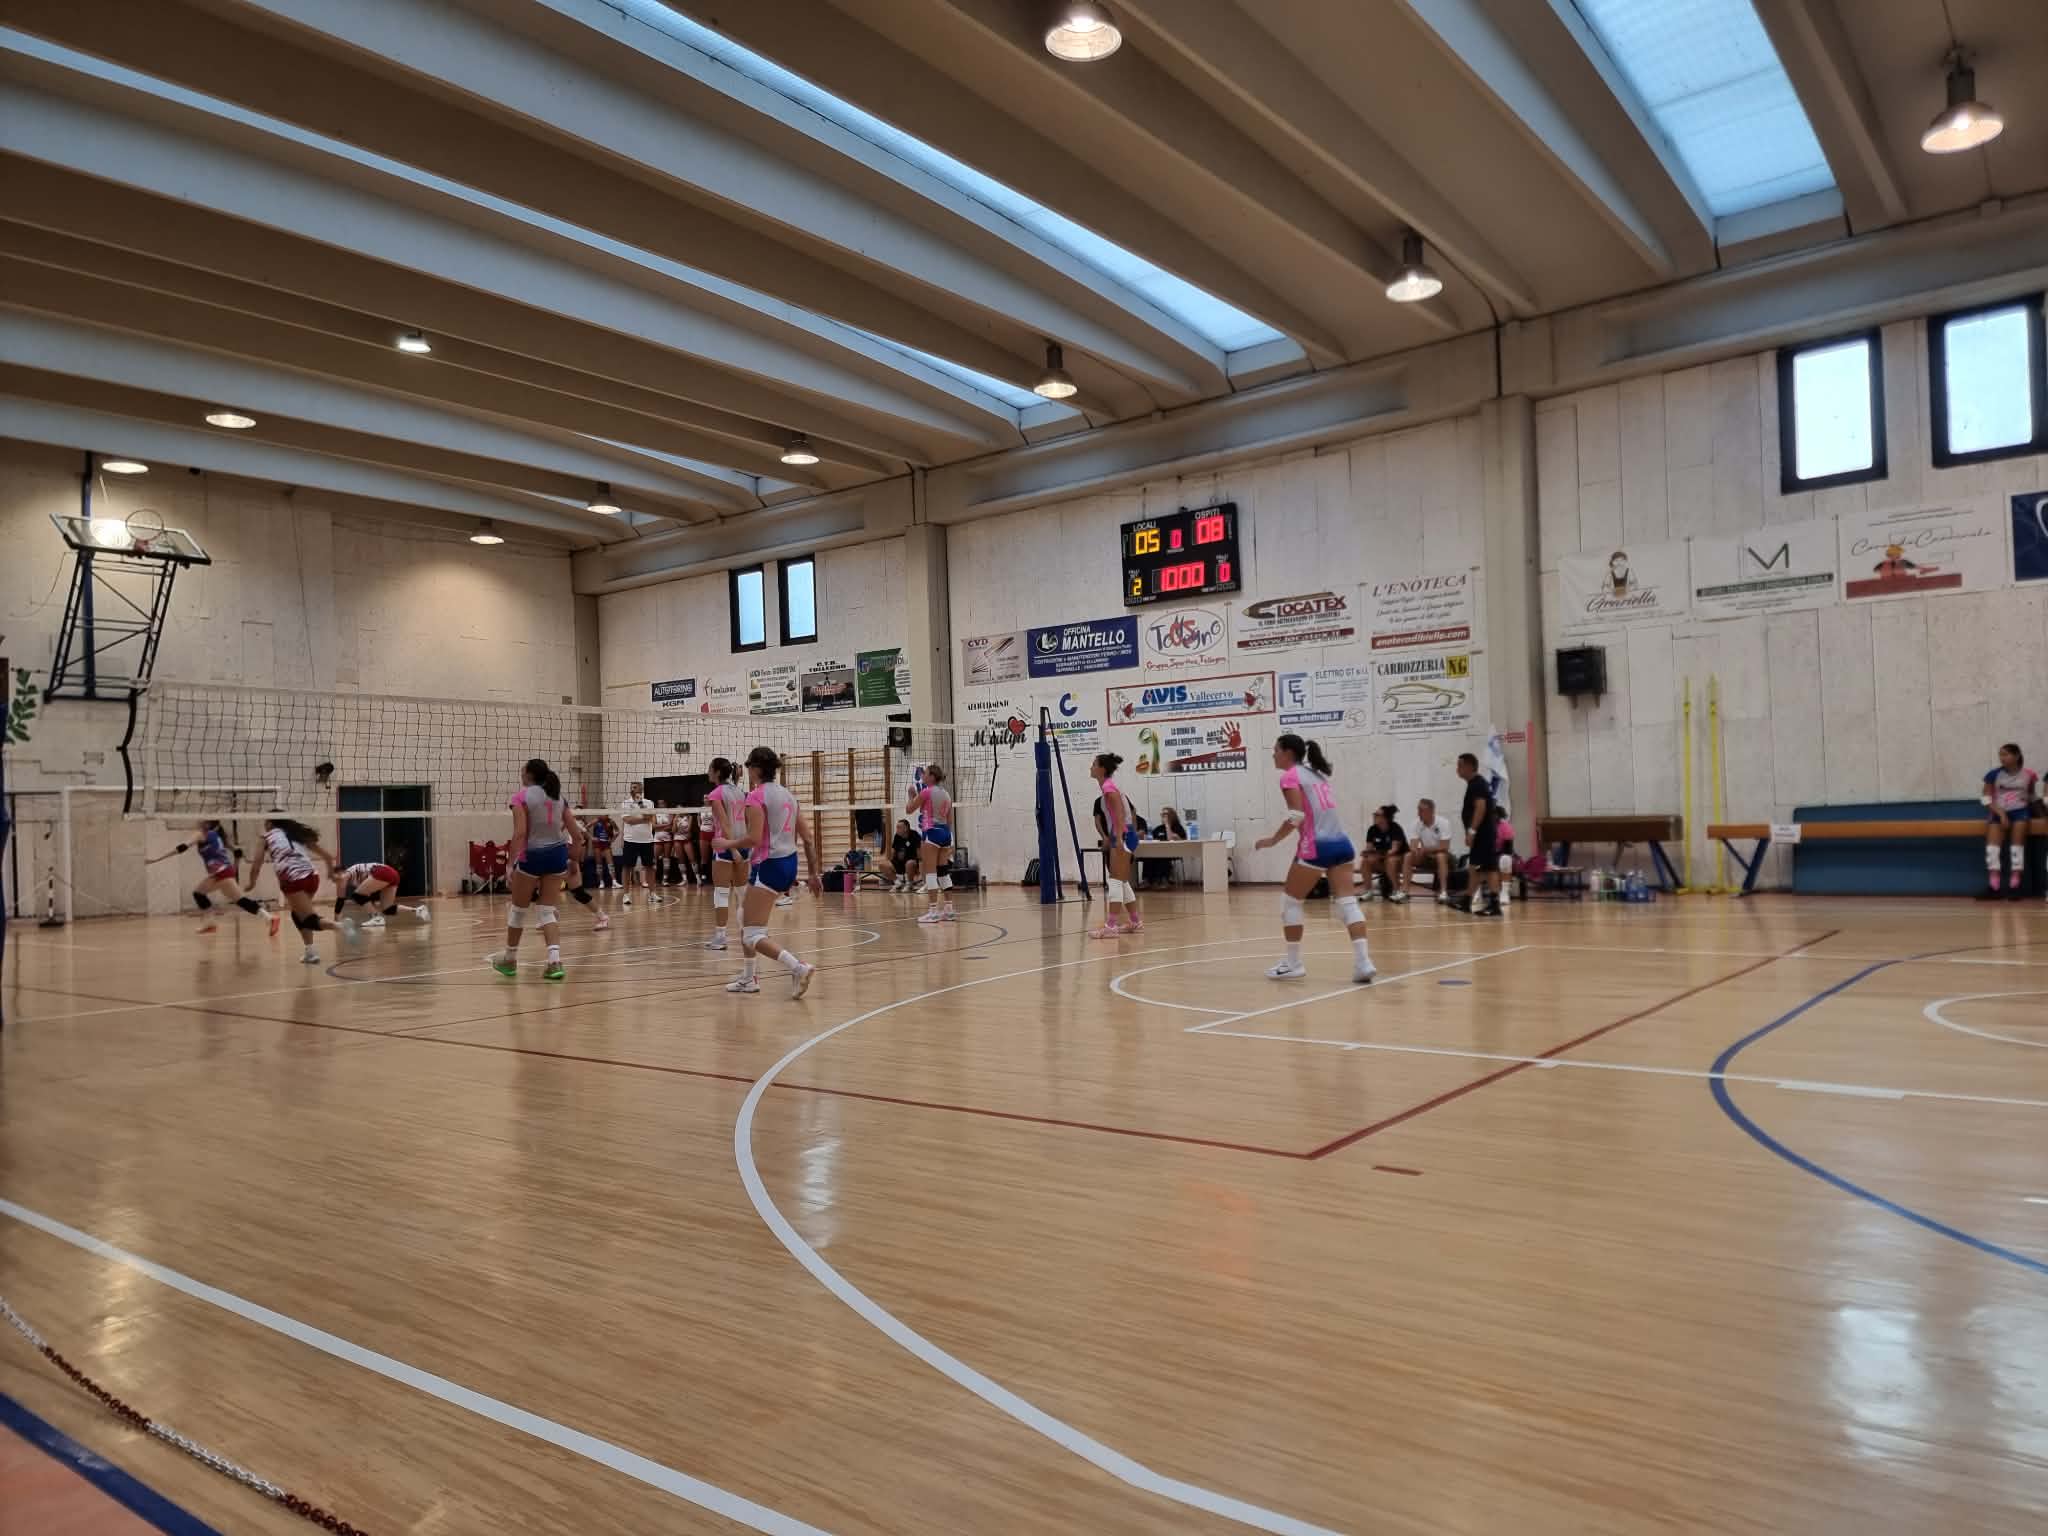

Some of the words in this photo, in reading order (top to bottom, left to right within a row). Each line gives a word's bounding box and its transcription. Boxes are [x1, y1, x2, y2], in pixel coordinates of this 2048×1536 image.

[1133, 521, 1157, 533] LOCALI
[1195, 514, 1225, 545] 08
[1135, 529, 1160, 555] 05
[1170, 529, 1182, 549] 0
[1220, 563, 1231, 583] 0
[1132, 577, 1142, 596] 2
[1373, 575, 1467, 597] L'ENOTECA
[1278, 596, 1347, 616] LOCATEX
[1062, 629, 1125, 651] MANTELLO
[1063, 625, 1091, 636] OFFICINA
[1377, 657, 1445, 676] CARROZZERIA
[1448, 658, 1467, 675] NG
[1142, 685, 1187, 705] AVIS
[1071, 719, 1098, 729] GROUP
[1182, 760, 1245, 771] TOLLEGNO
[782, 802, 794, 833] 2
